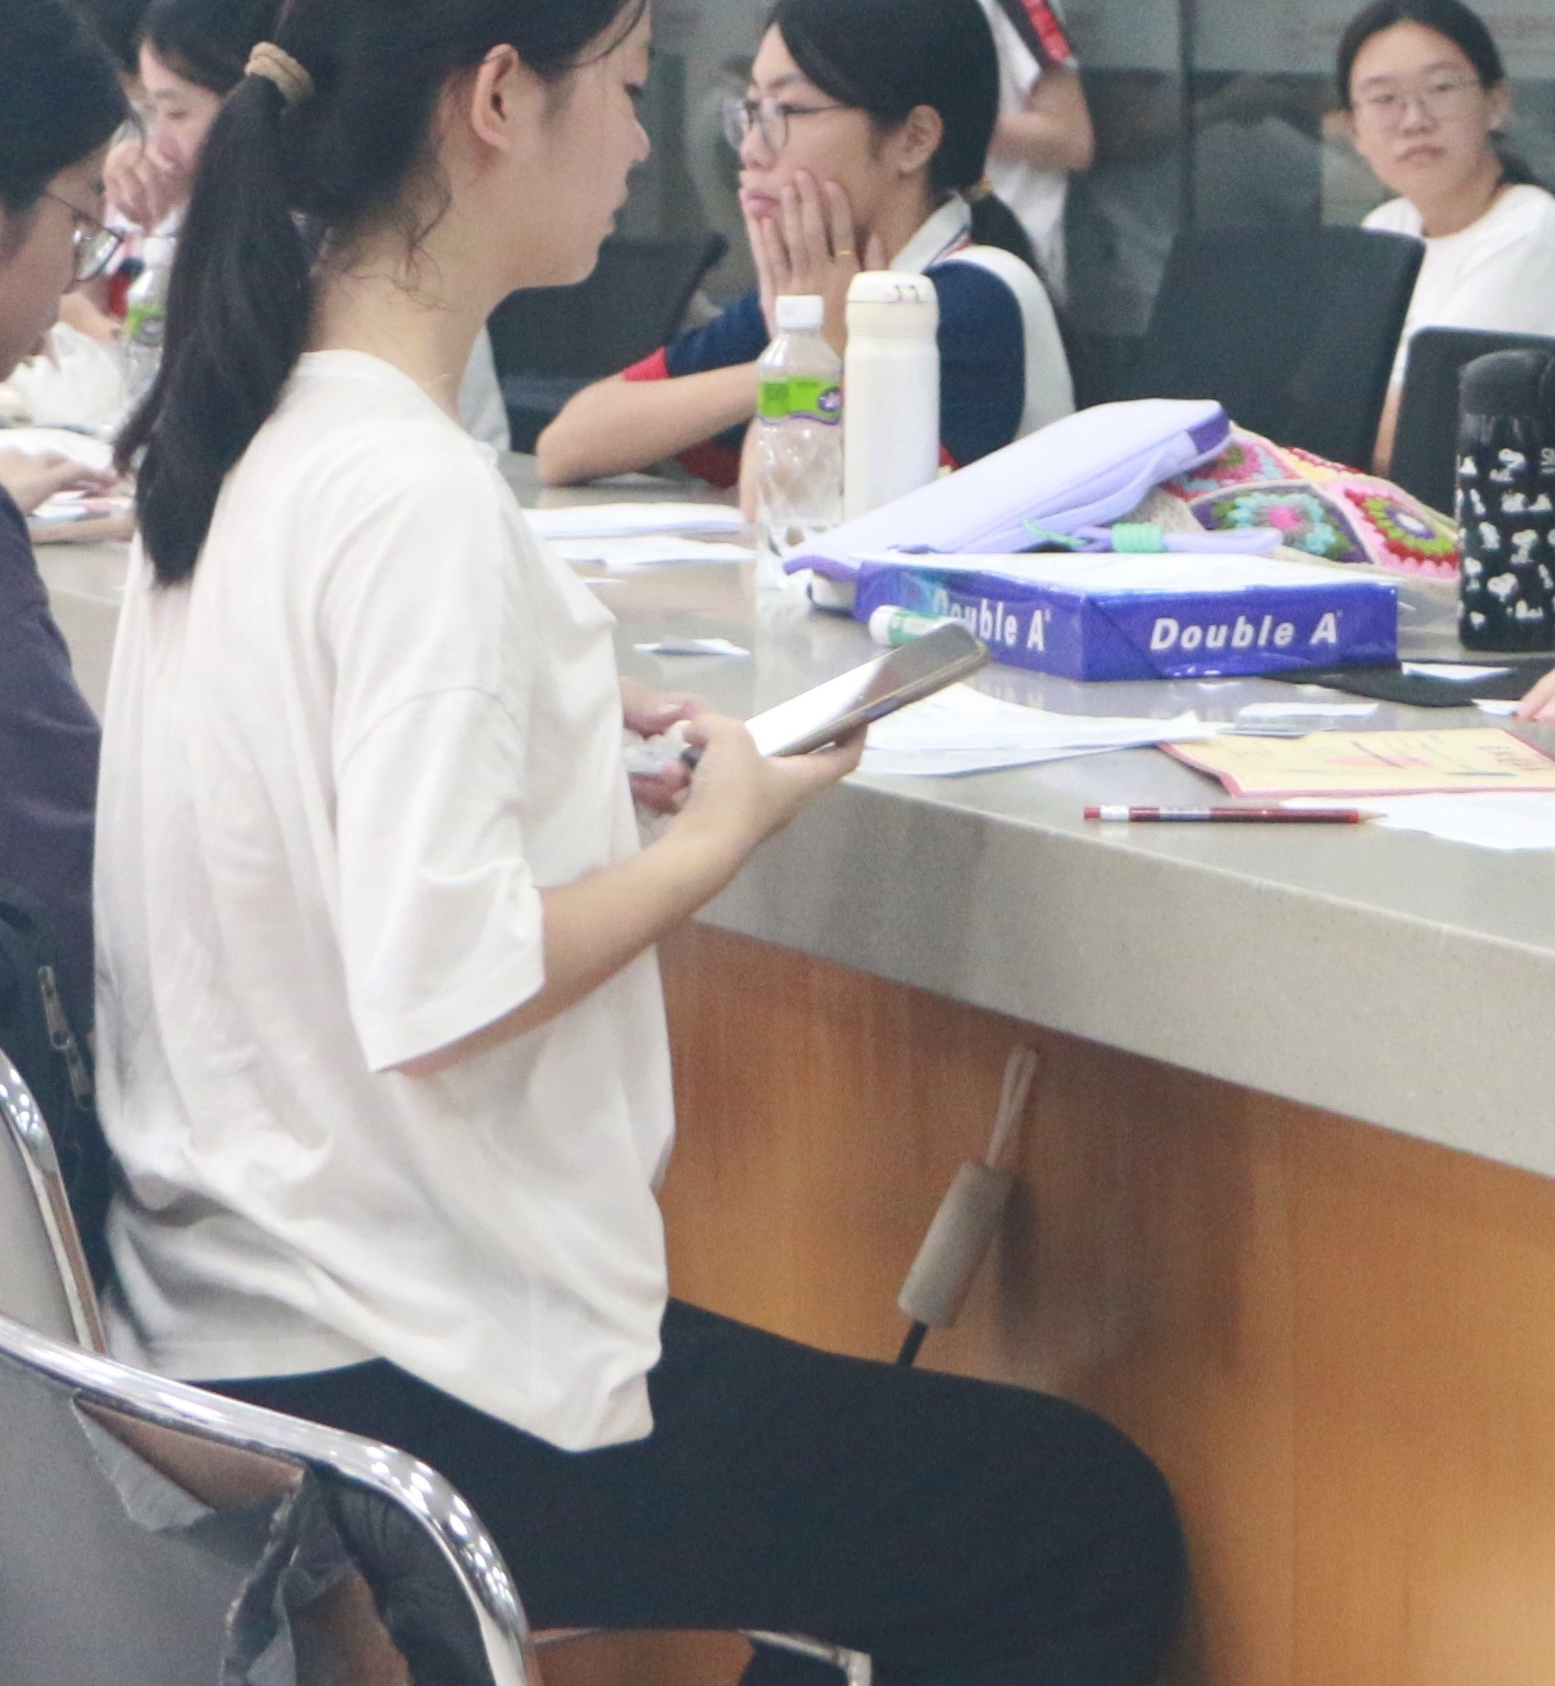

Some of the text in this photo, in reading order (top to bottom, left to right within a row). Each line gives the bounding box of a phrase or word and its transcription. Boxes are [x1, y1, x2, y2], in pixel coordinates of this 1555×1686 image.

[1026, 609, 1044, 651] A
[1150, 612, 1338, 651] Double A
